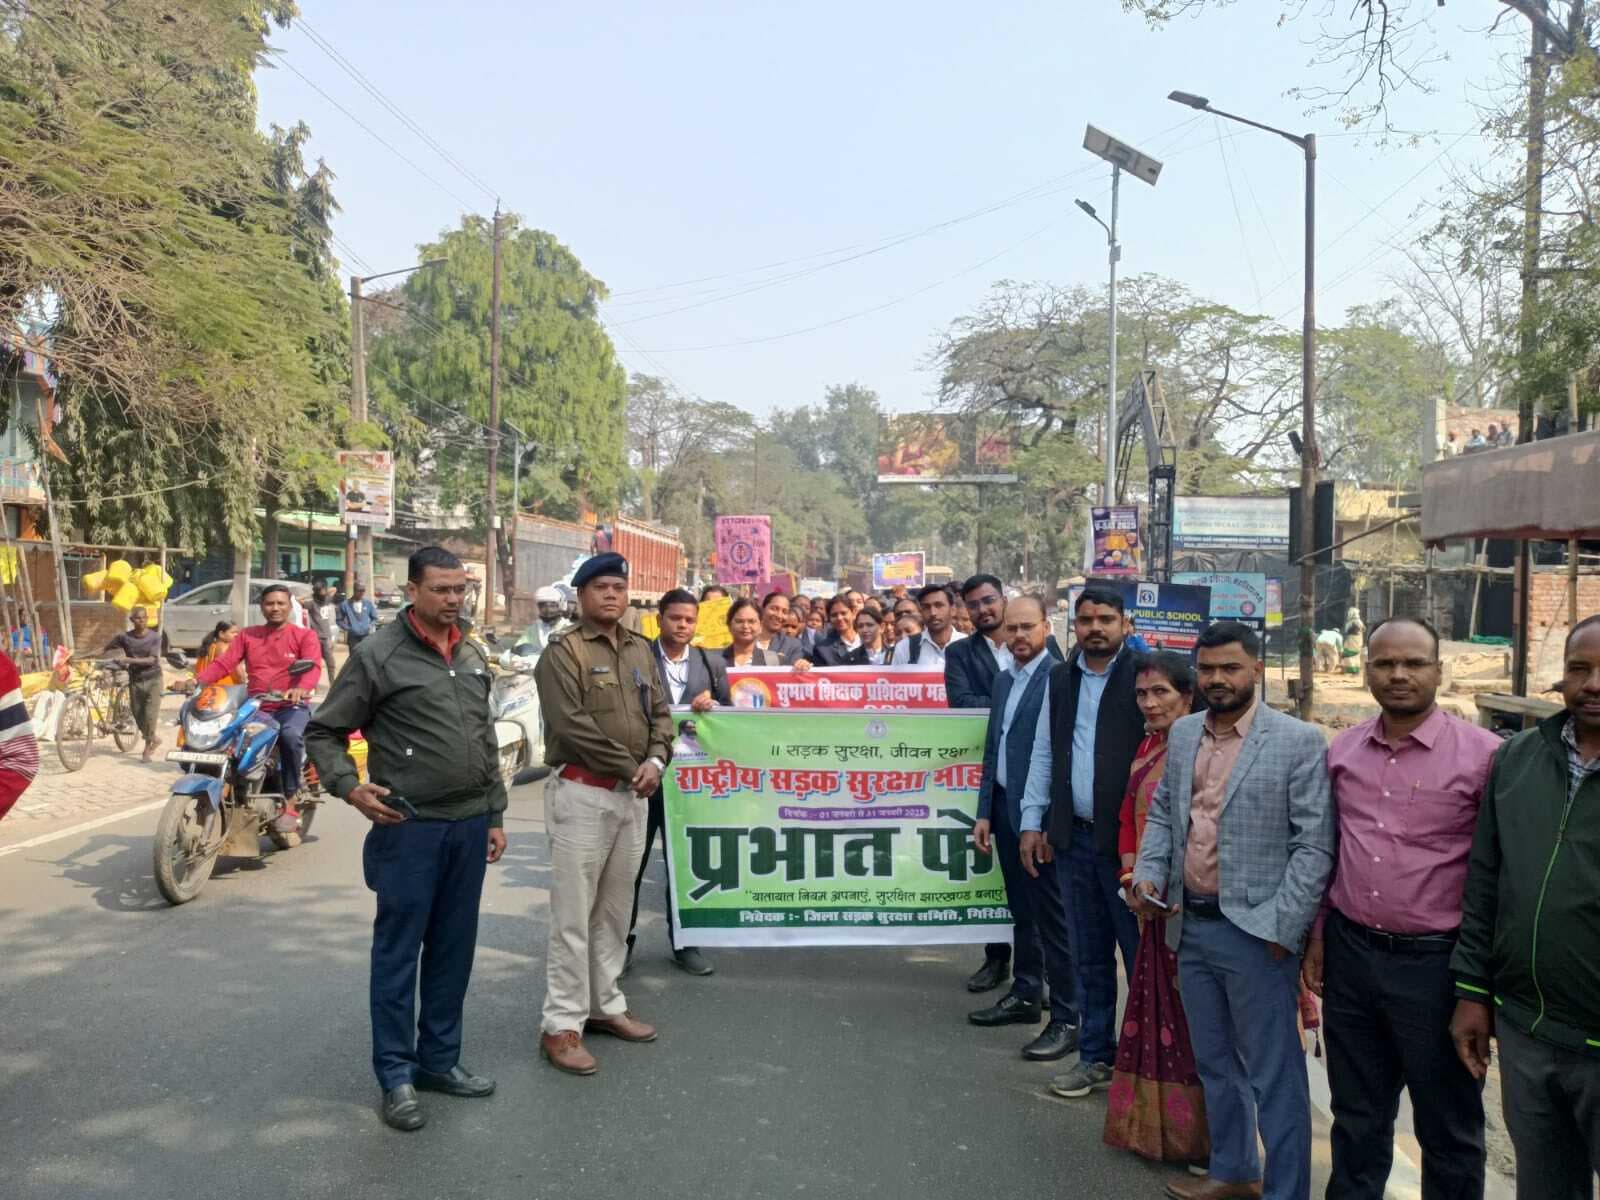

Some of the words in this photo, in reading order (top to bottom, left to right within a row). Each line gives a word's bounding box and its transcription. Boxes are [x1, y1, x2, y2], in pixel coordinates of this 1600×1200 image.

[1135, 609, 1165, 619] PUBLIC
[1167, 611, 1203, 622] SCHOOL
[818, 678, 864, 701] शिक्षक
[786, 744, 828, 760] सड़क
[890, 743, 931, 759] जीवन
[675, 759, 763, 796] राष्ट्रीय
[769, 768, 839, 799] सड़क
[846, 770, 928, 802] सुरक्षा
[686, 826, 901, 901] प्रभात
[798, 887, 827, 901] नियम
[876, 887, 916, 905] सुरक्षित
[920, 889, 971, 902] झारखण्ड
[739, 909, 785, 922] निवेदक
[804, 909, 839, 922] जिला
[842, 911, 873, 923] सड़क
[877, 911, 913, 925] सुरक्षा
